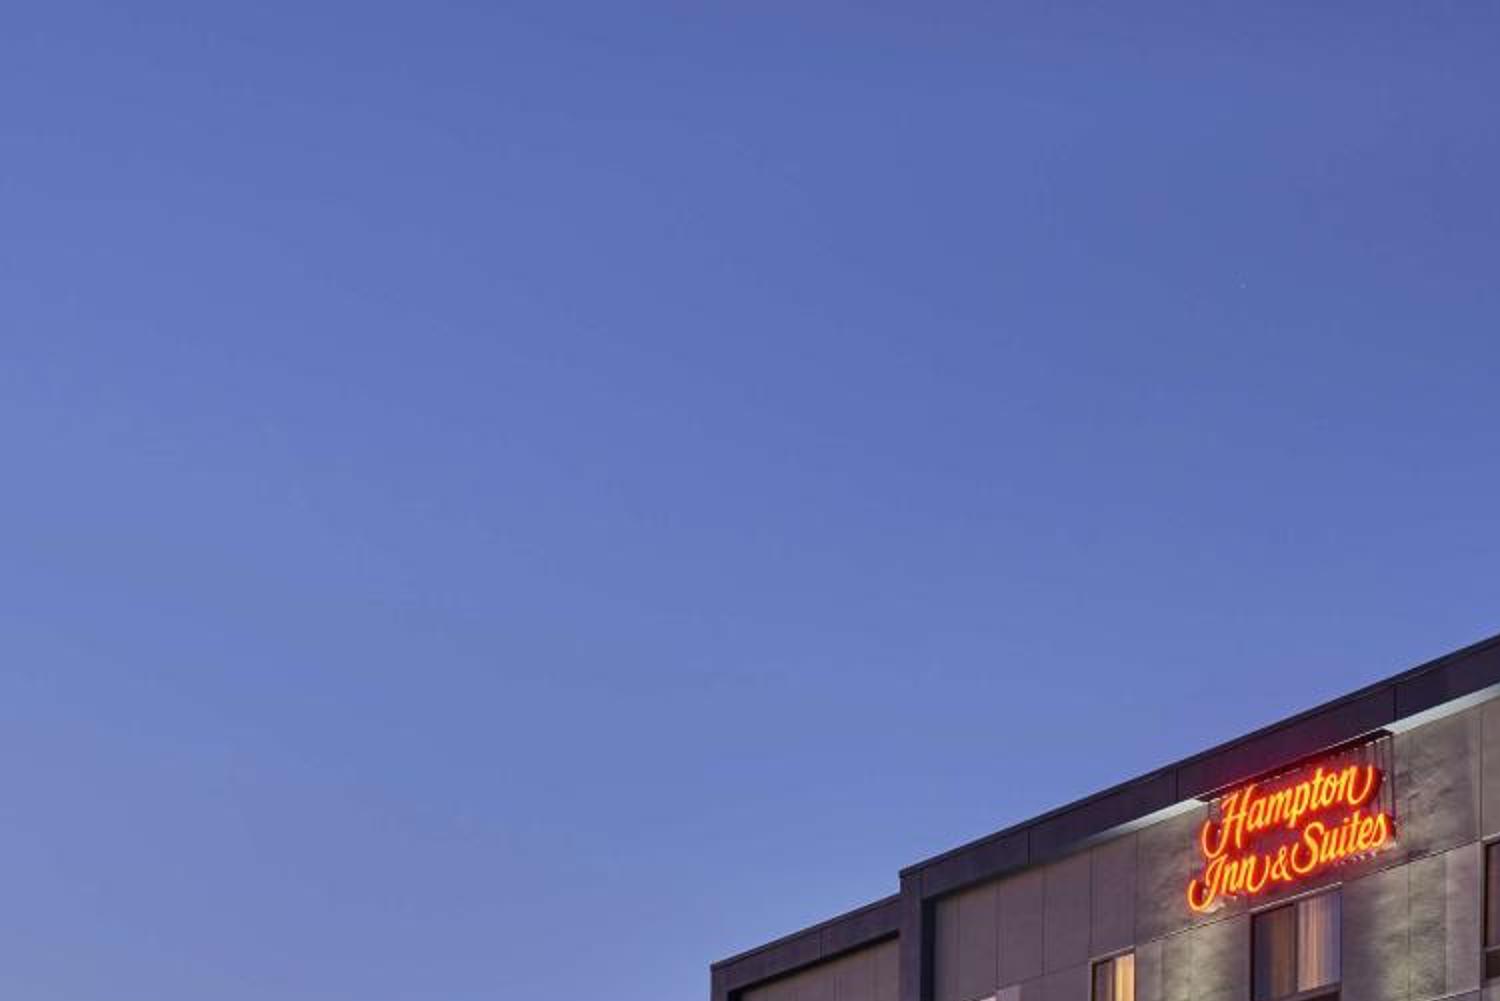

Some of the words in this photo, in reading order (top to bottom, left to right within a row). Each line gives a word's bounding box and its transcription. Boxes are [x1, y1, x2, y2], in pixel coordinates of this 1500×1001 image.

[1201, 763, 1374, 858] Hampton
[1187, 852, 1271, 912] Inn
[1271, 846, 1292, 880] &
[1291, 810, 1387, 873] Suites
